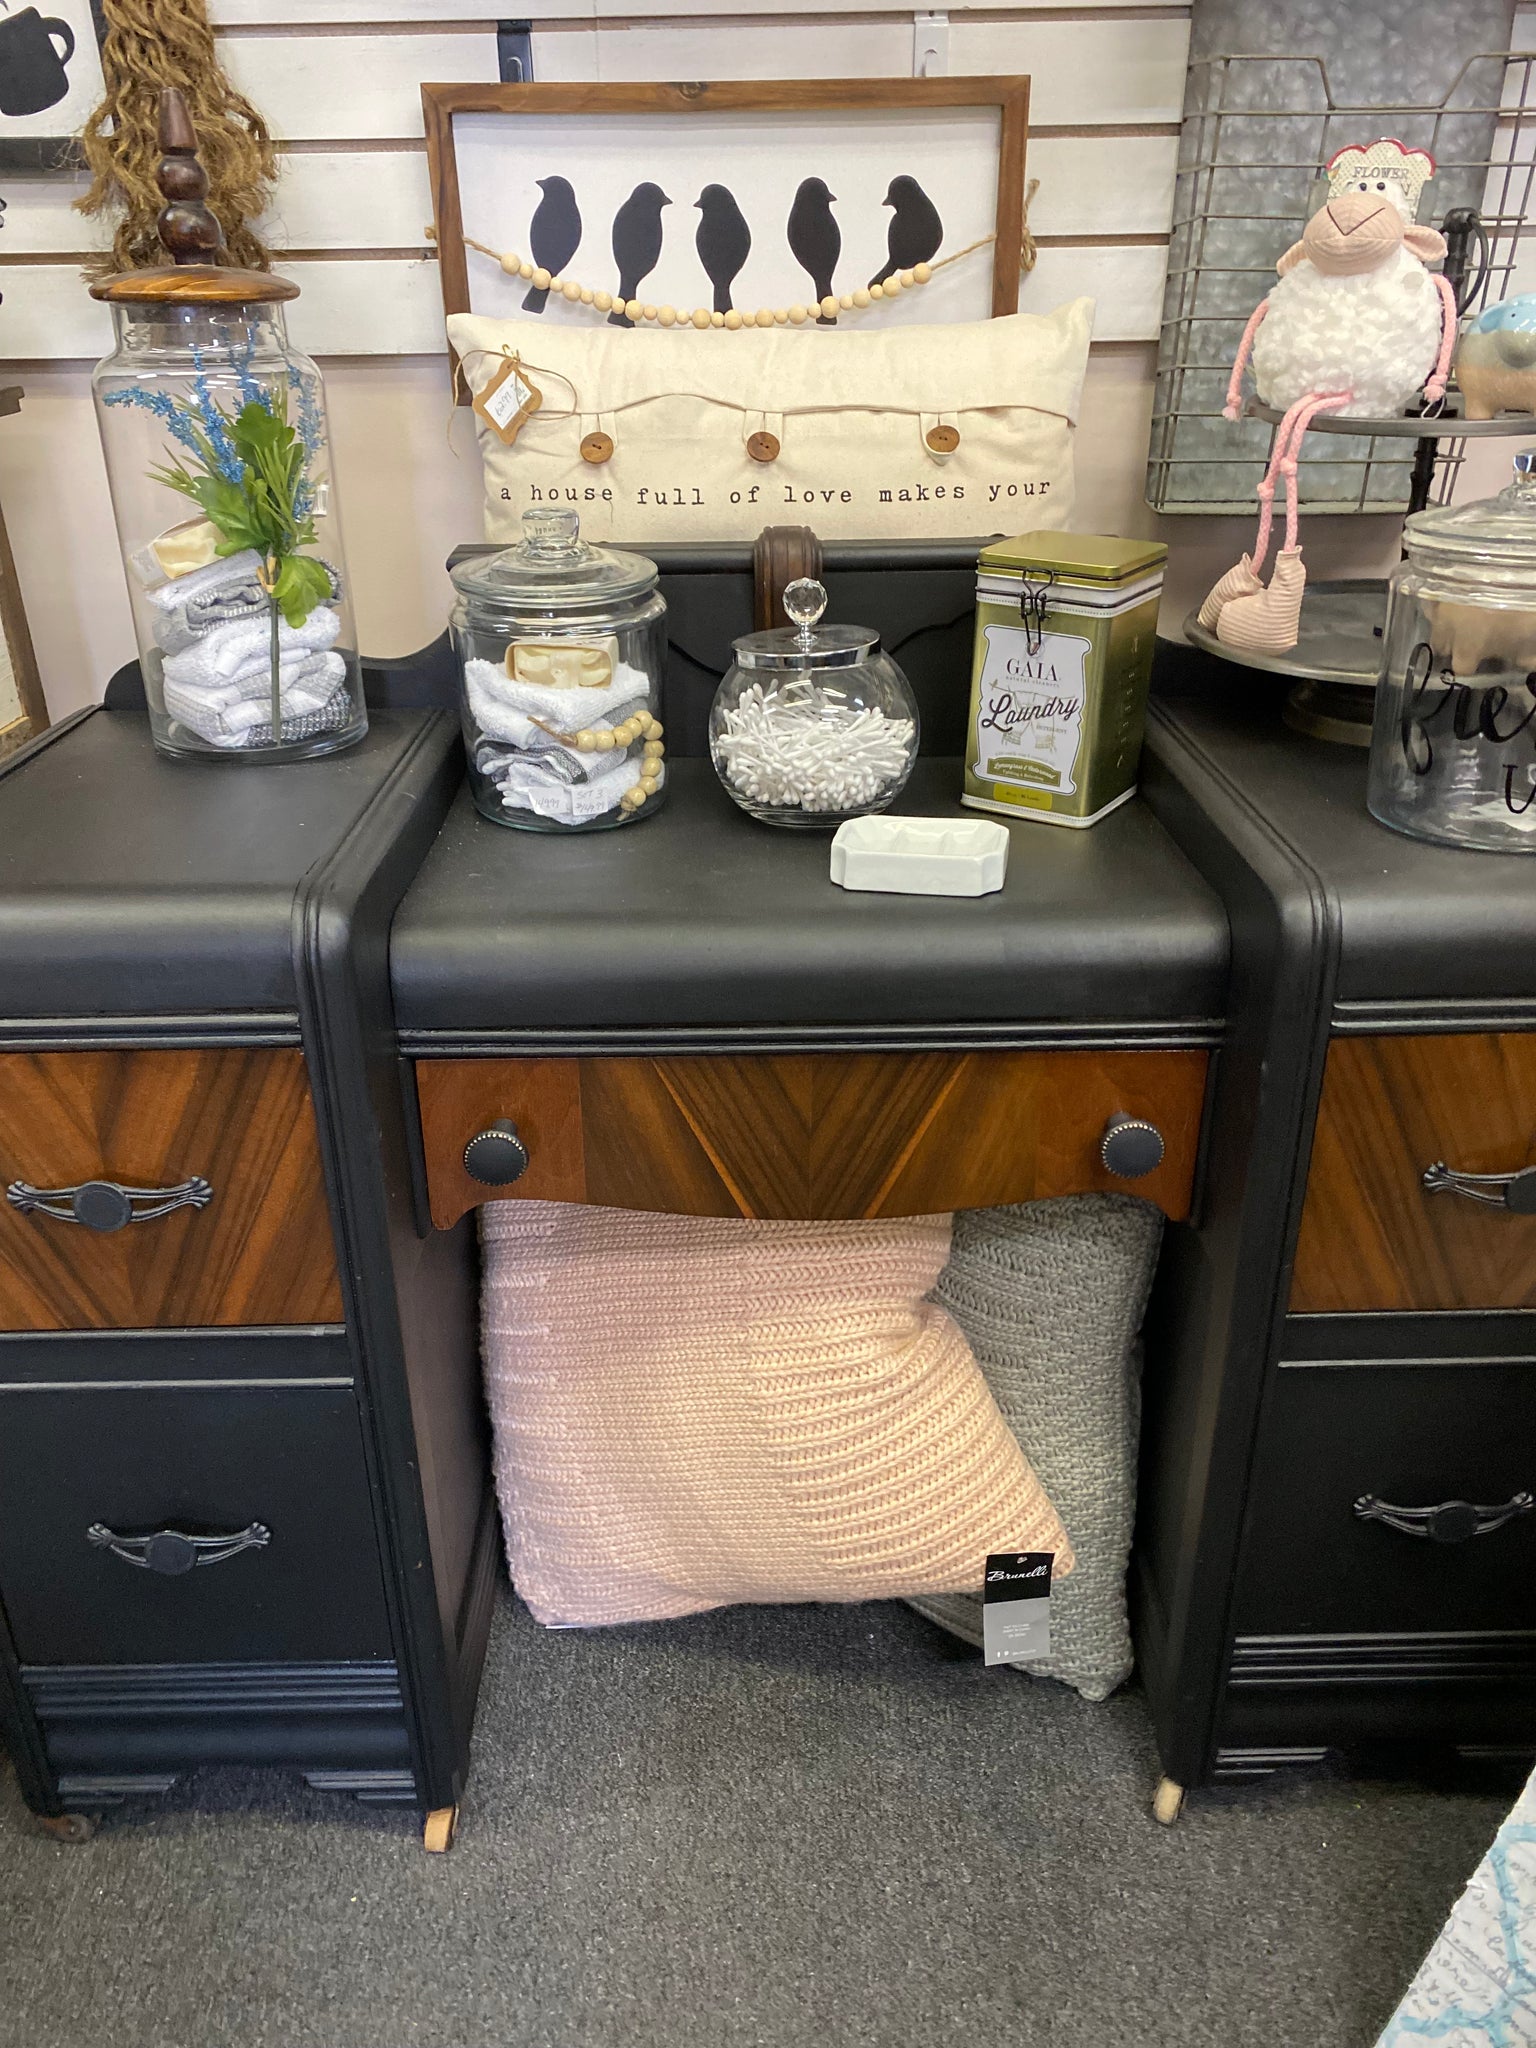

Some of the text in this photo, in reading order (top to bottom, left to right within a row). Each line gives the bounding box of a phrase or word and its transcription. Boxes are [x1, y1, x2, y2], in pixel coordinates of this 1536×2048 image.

[1352, 166, 1410, 180] FLOWER
[501, 481, 1050, 505] a house full of love makes your
[1006, 658, 1058, 682] GAIA
[981, 694, 1080, 733] Laundry
[986, 1564, 1049, 1582] Brunelli
